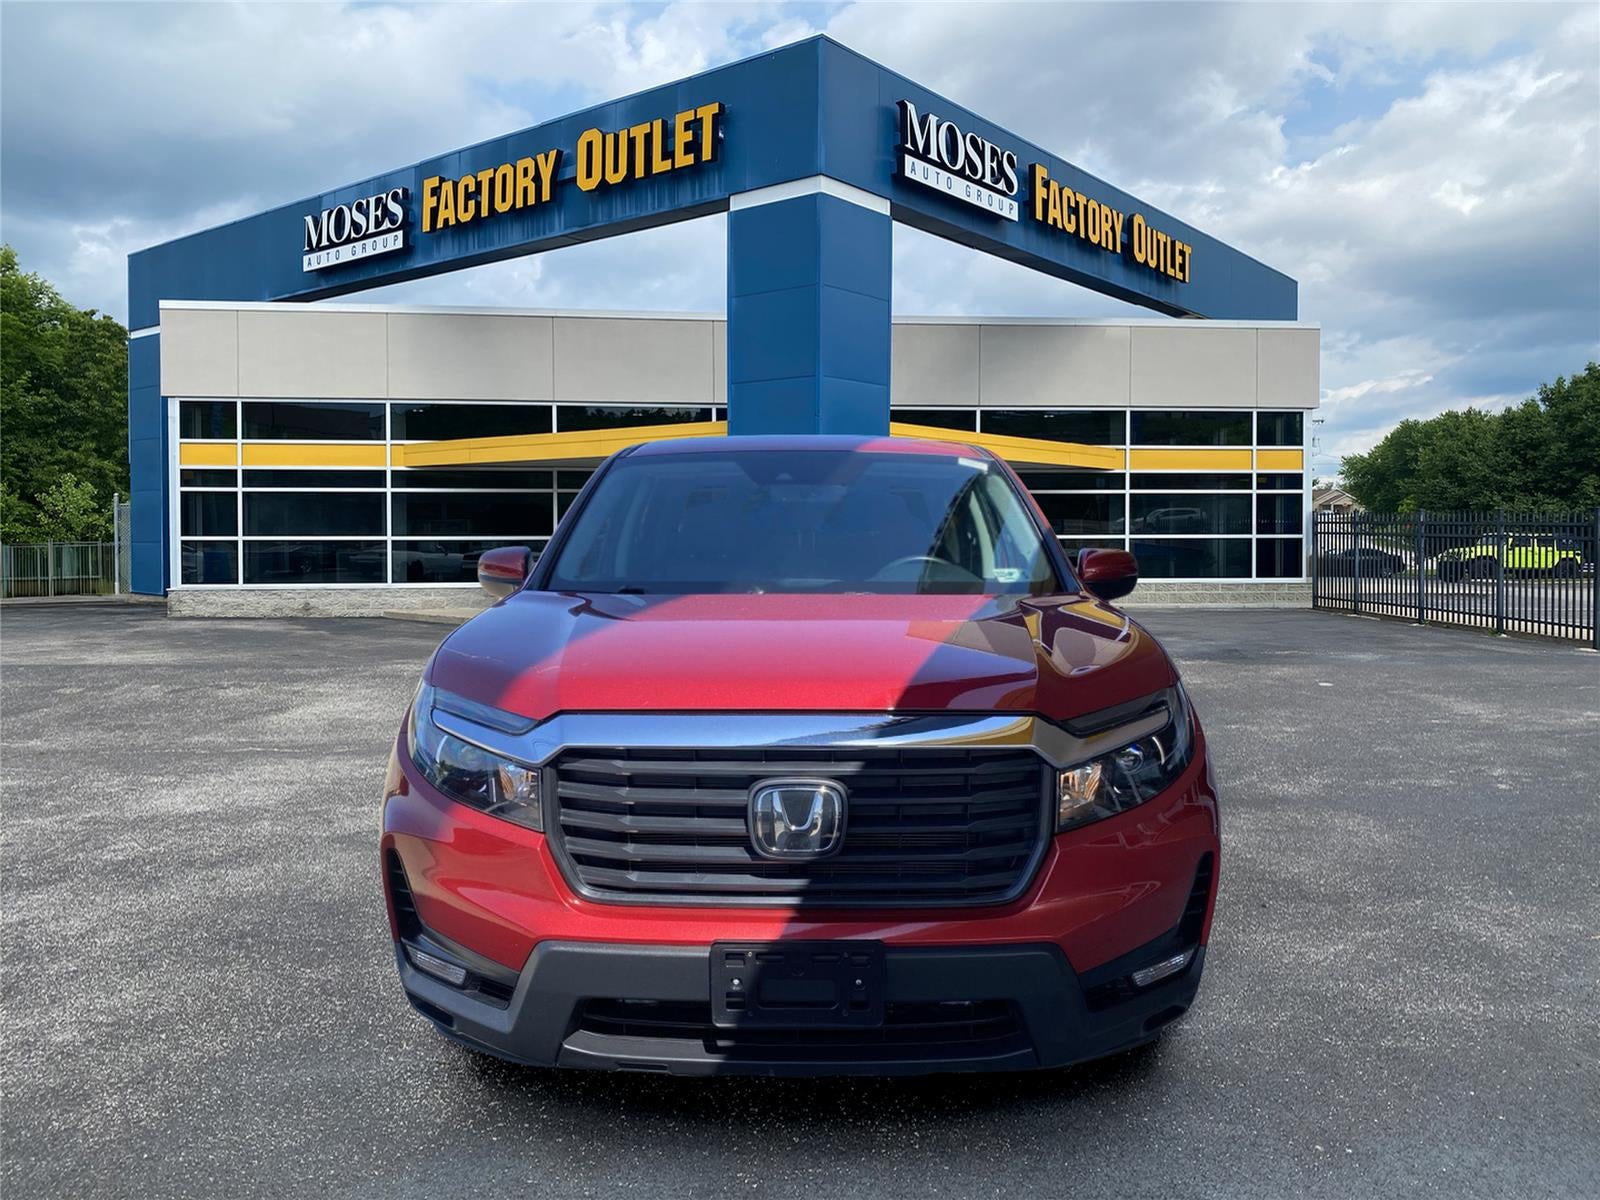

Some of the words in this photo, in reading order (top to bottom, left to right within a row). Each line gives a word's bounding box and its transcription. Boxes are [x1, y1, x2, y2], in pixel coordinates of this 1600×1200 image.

[422, 149, 558, 233] FACTORY
[576, 102, 720, 191] OUTLET
[904, 100, 1018, 196] MOSES
[910, 161, 952, 190] AUTO
[965, 184, 1014, 215] GROUP
[303, 187, 403, 251] MOSES
[307, 250, 340, 268] AUTO
[351, 234, 399, 256] GROUP
[1034, 163, 1124, 253] FACTORY
[1132, 213, 1192, 283] OUTLET
